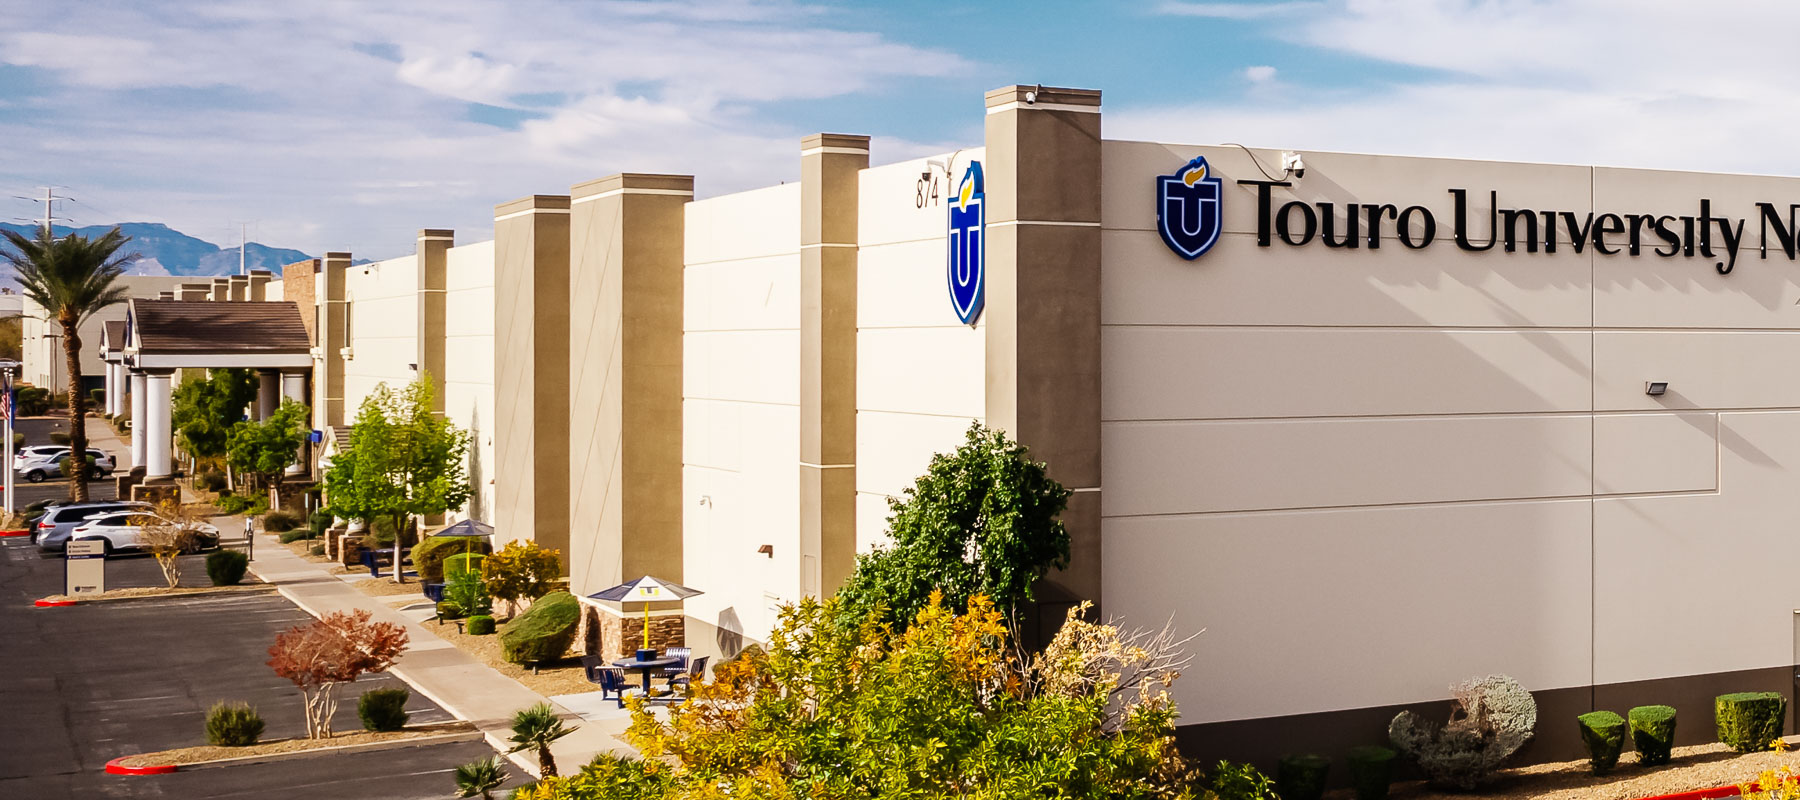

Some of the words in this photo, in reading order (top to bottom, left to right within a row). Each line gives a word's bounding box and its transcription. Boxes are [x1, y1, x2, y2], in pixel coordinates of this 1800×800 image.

[916, 176, 939, 209] 874
[1236, 179, 1437, 250] Touro
[1448, 188, 1746, 275] University
